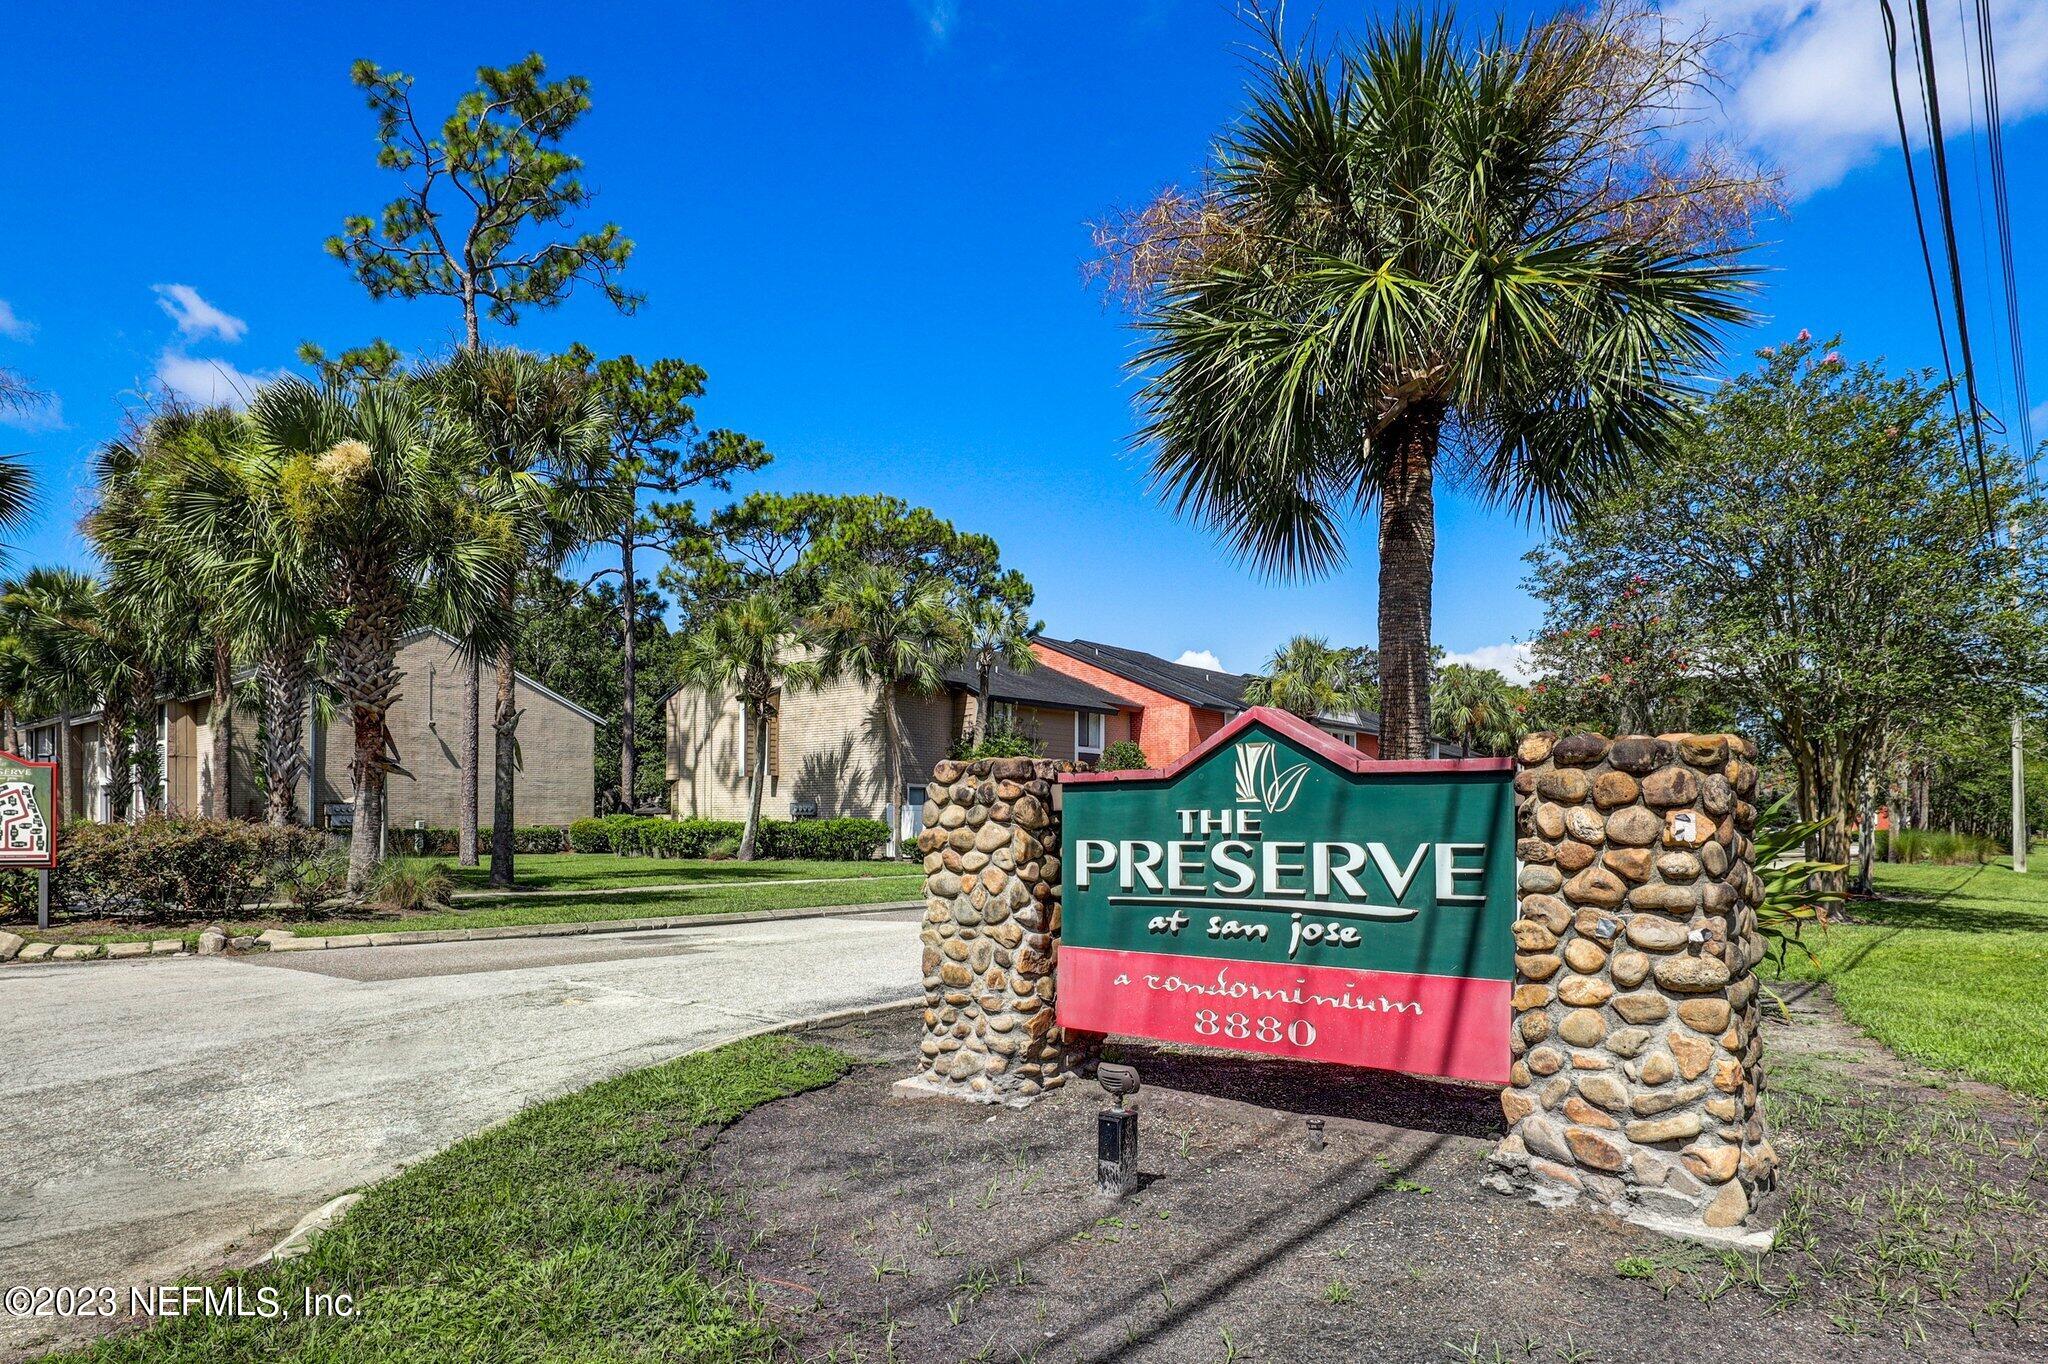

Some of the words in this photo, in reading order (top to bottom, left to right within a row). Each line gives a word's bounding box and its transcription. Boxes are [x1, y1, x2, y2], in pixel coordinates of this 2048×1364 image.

[1176, 808, 1262, 835] THE
[1075, 839, 1487, 901] PRESERVE
[1147, 909, 1189, 933] at
[1206, 915, 1268, 939] san
[1288, 912, 1362, 960] jose
[1113, 972, 1131, 986] a
[1143, 967, 1424, 1016] condominium
[1194, 1008, 1317, 1047] 8880
